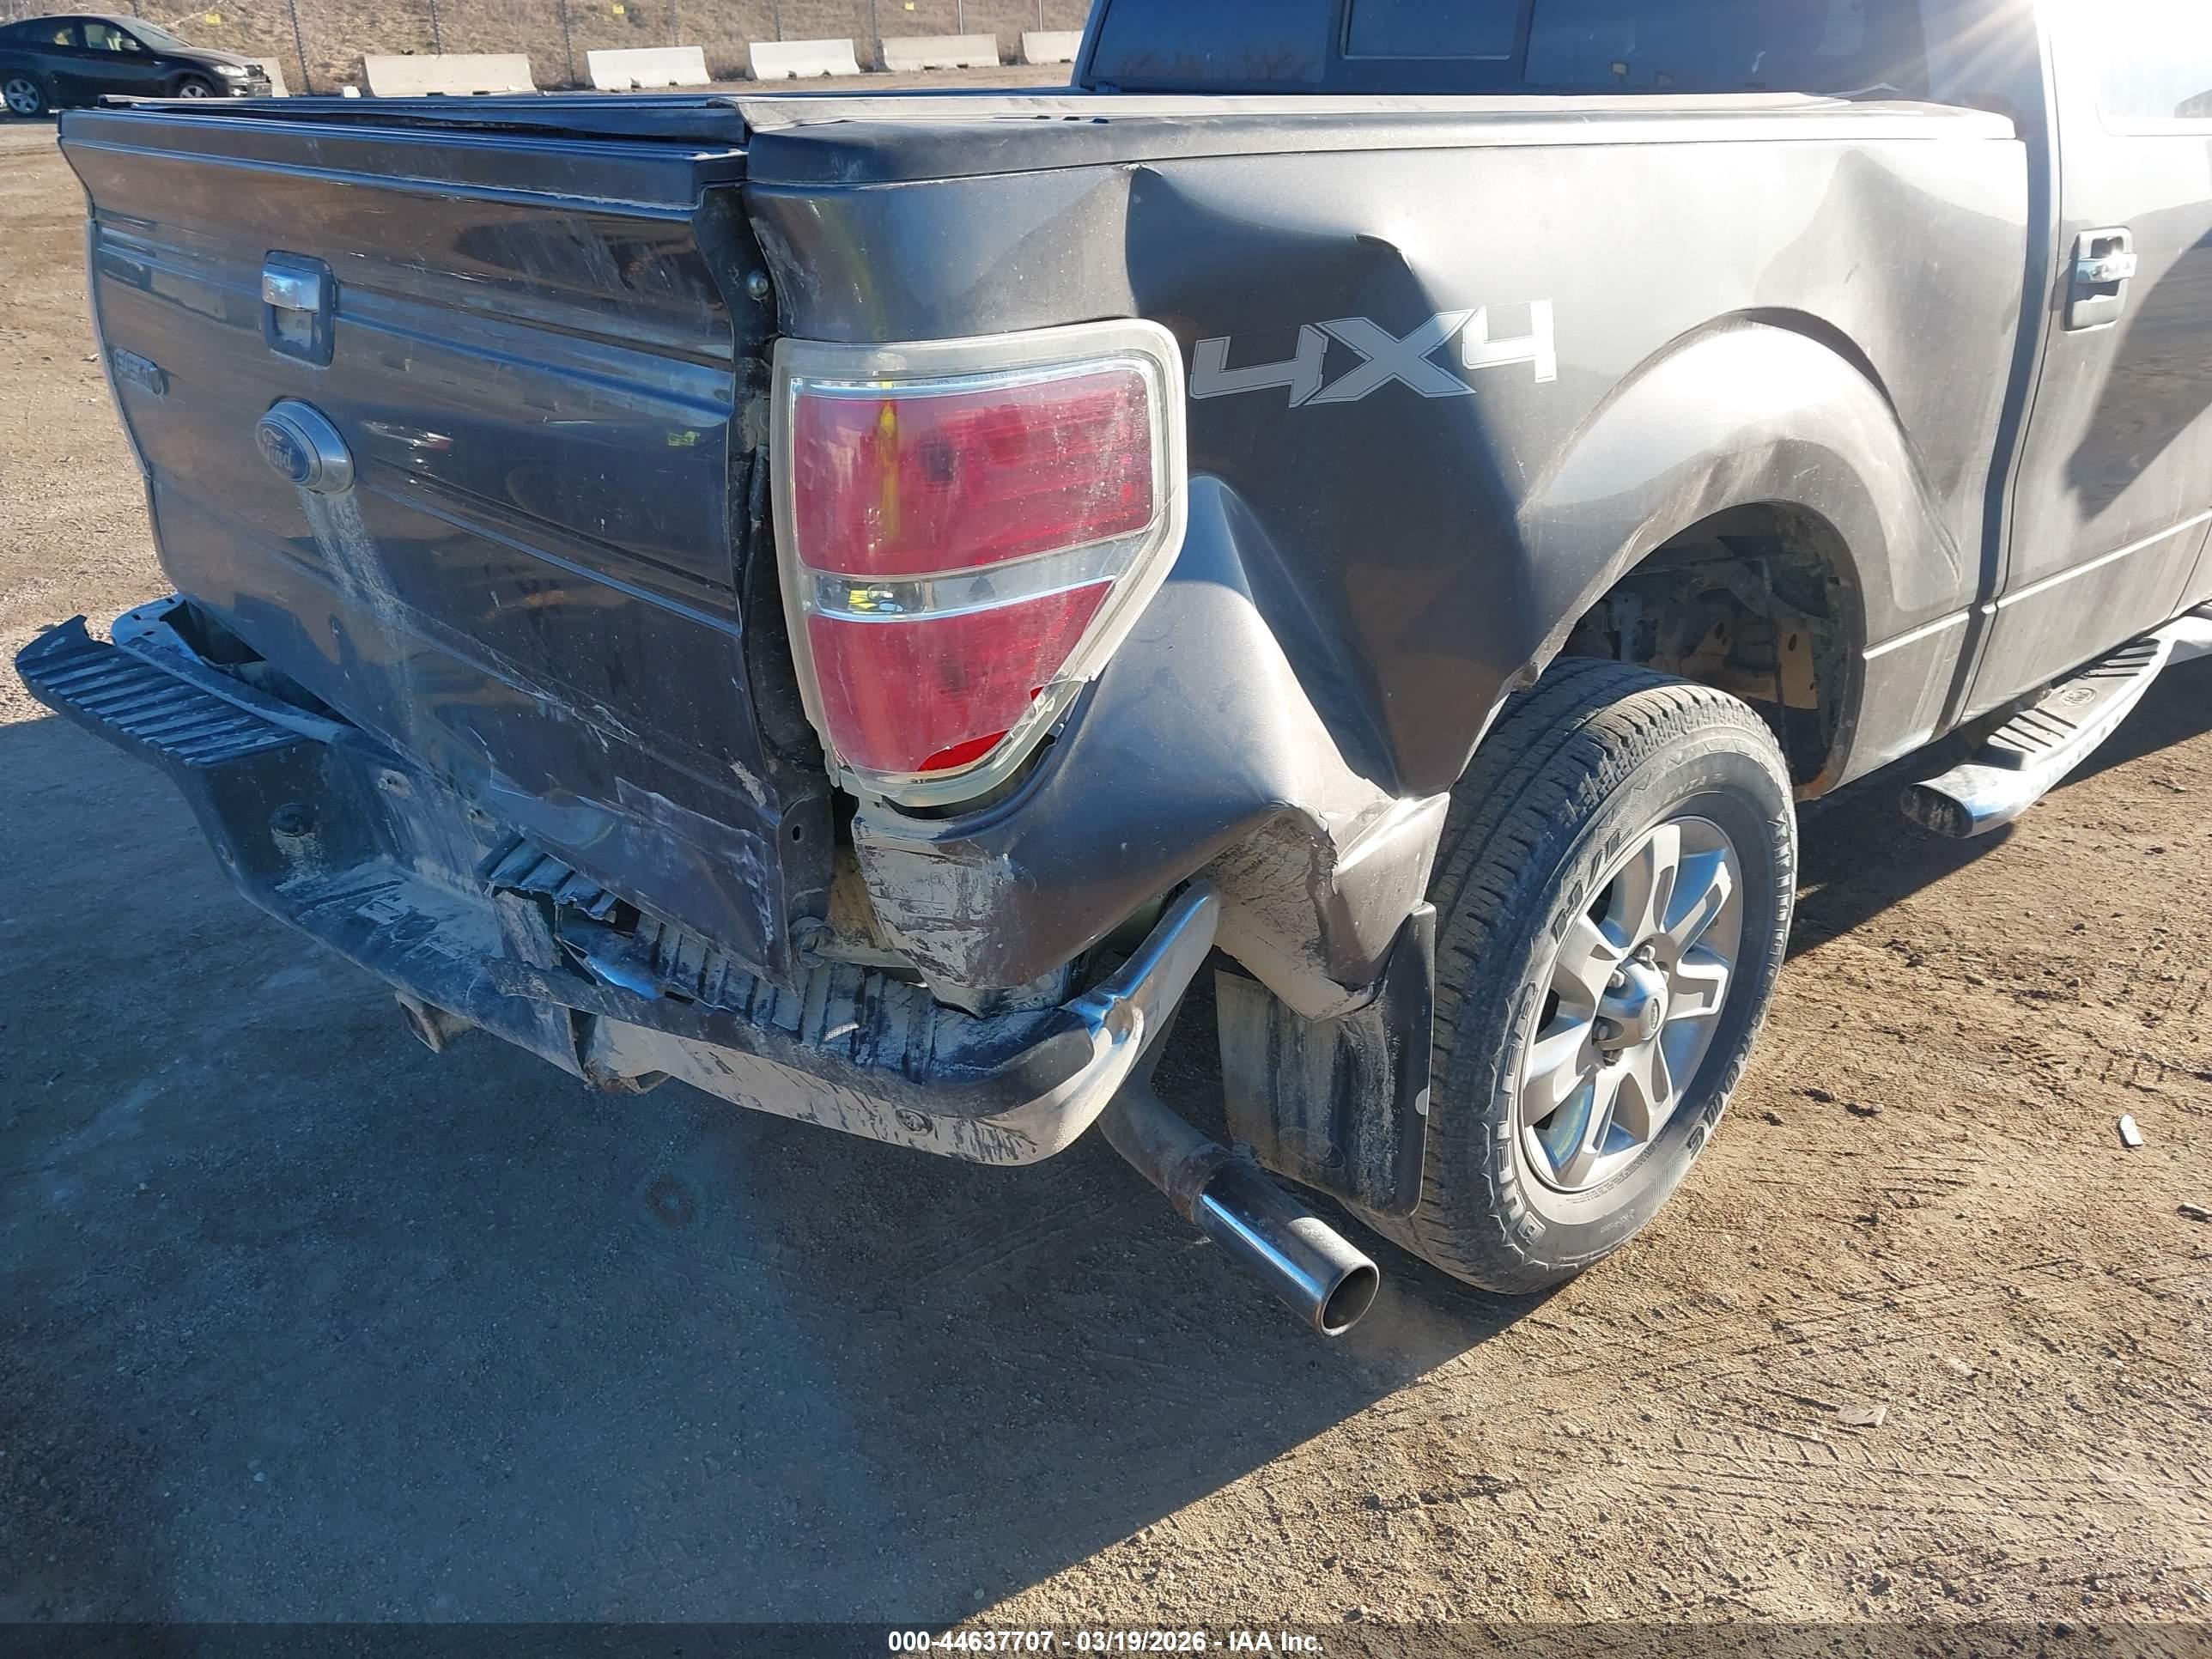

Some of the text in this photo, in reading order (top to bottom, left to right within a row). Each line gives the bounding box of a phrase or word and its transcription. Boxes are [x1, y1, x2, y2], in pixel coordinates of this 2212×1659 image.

[1189, 298, 1558, 409] 4X4
[261, 427, 295, 472] Ford
[1497, 981, 1546, 1245] DUELER
